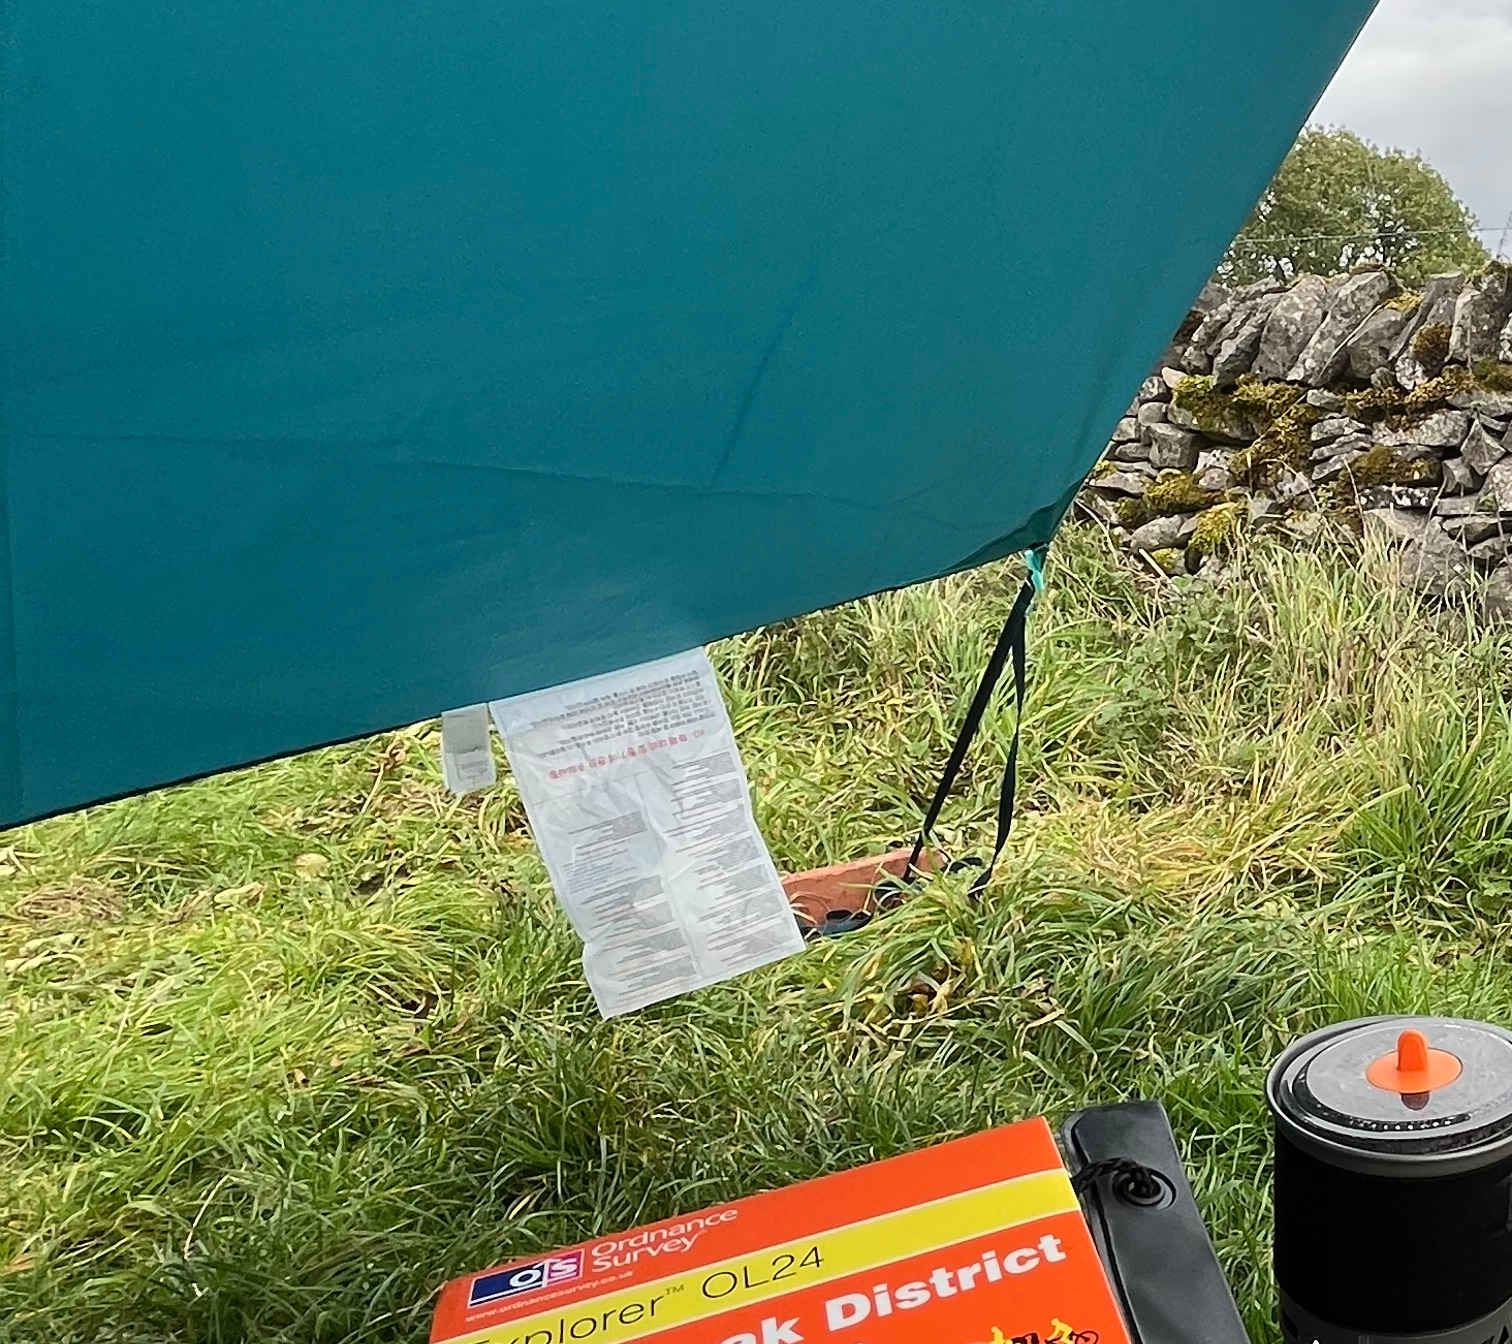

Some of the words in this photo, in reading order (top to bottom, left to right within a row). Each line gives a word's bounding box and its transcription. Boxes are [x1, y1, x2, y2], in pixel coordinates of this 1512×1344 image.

[591, 1207, 738, 1255] Ordnance
[591, 1232, 700, 1273] Survey
[700, 1245, 825, 1300] OL24
[824, 1233, 1068, 1333] District
